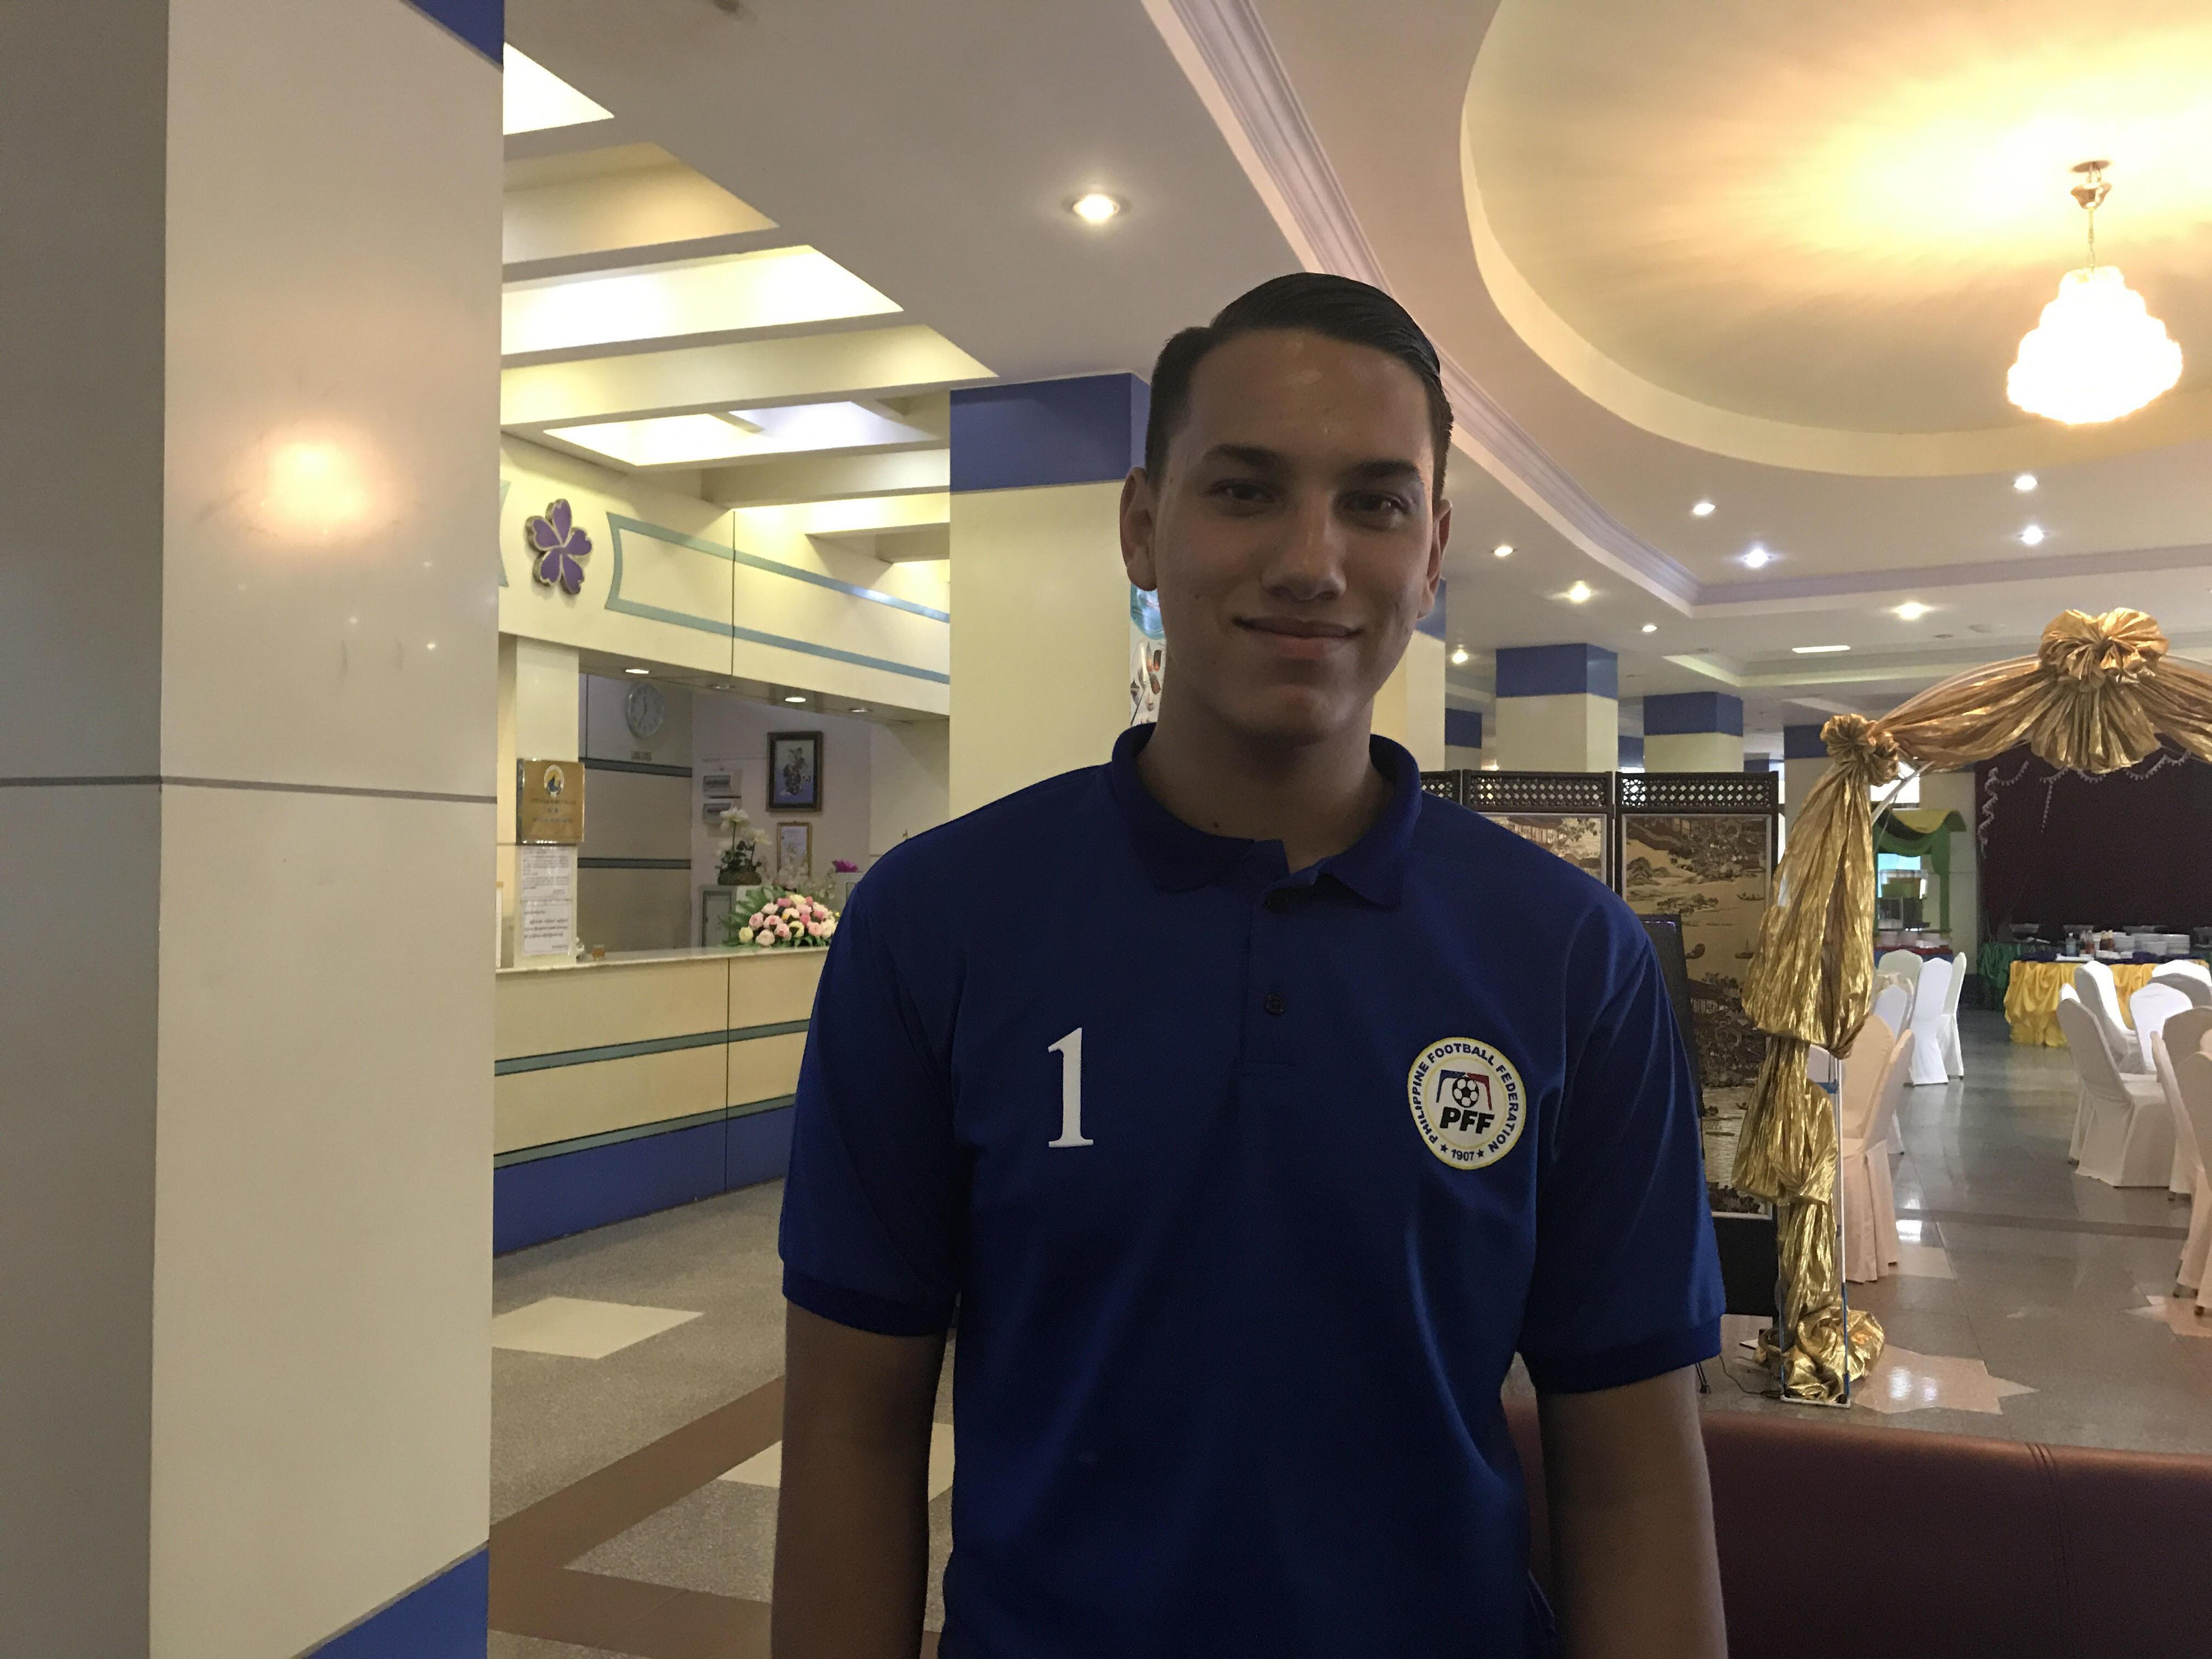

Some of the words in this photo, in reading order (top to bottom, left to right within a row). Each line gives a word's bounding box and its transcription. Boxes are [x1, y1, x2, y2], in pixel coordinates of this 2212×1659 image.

[1047, 1027, 1094, 1148] 1
[1412, 1061, 1438, 1144] PHILIPPINE
[1426, 1043, 1494, 1066] FOOTBALL
[1488, 1064, 1519, 1153] FEDERATION
[1439, 1106, 1496, 1135] PFF
[1451, 1149, 1475, 1161] 1907
